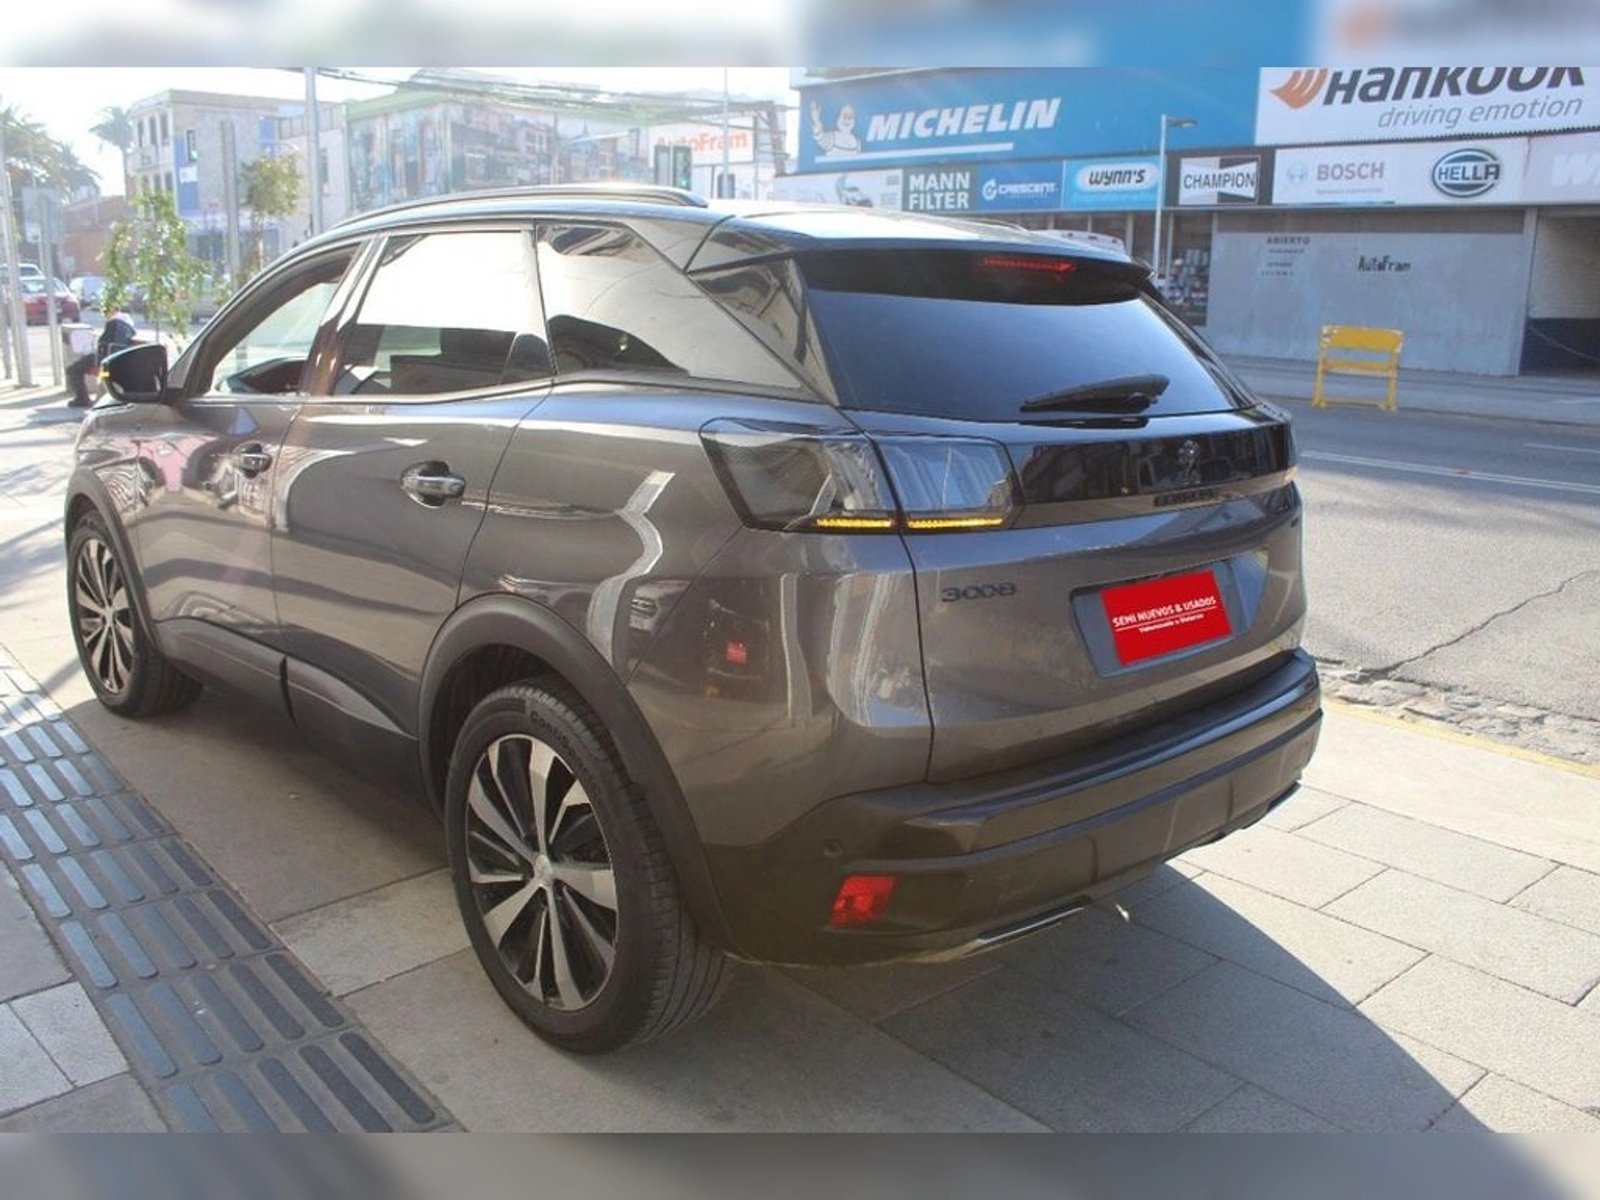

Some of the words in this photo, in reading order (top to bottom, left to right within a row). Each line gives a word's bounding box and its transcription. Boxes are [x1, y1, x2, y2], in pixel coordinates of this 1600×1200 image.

[866, 98, 1061, 142] MICHELIN
[1378, 104, 1462, 128] driving
[1469, 96, 1583, 122] emotion
[1183, 172, 1256, 189] CHAMPION
[1316, 161, 1385, 181] BOSCH
[1438, 164, 1500, 181] HELLA
[909, 172, 970, 192] MANN
[909, 191, 969, 210] FILTER
[942, 582, 1016, 602] 3008
